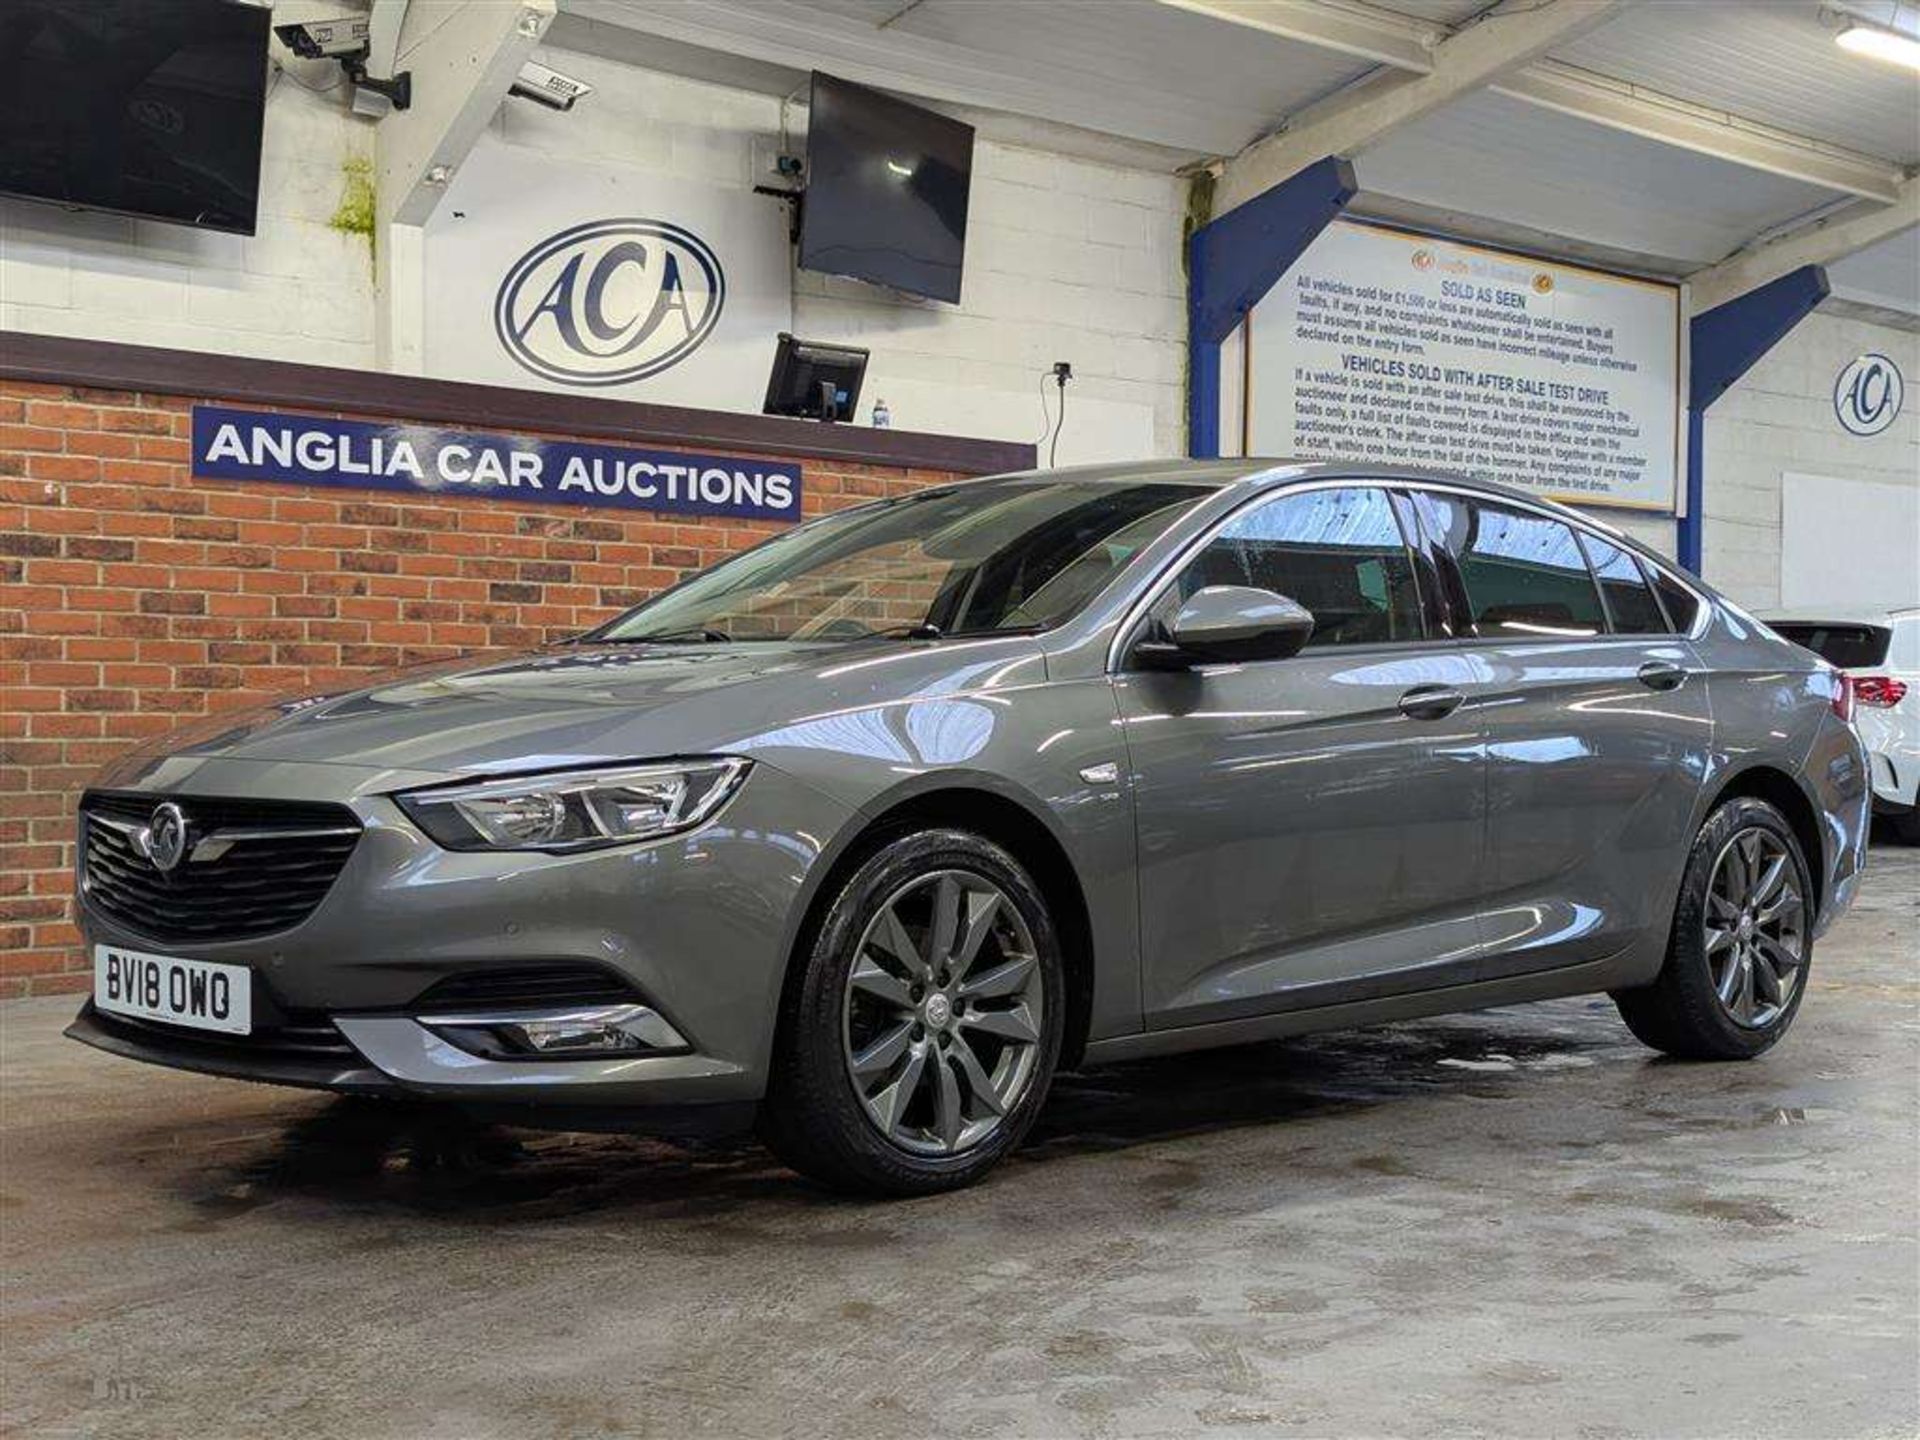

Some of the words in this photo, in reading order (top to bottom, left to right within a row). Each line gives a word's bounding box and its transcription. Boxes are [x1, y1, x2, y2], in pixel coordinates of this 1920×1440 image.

[516, 240, 696, 358] ACA
[1312, 277, 1352, 295] vehicles
[1441, 279, 1473, 300] SOLD
[1476, 285, 1491, 303] AS
[1495, 289, 1526, 309] SEEN
[1296, 325, 1338, 342] declared
[1357, 334, 1371, 347] the
[1378, 321, 1416, 338] vehicles
[1313, 370, 1347, 386] vehicle
[1362, 376, 1382, 390] sold
[1341, 354, 1404, 377] VEHICLES
[1409, 363, 1440, 382] SOLD
[1444, 368, 1473, 387] WITH
[1477, 373, 1513, 392] AFTER
[1516, 378, 1545, 396] SALE
[1548, 383, 1574, 400] TEST
[1578, 387, 1608, 405] DRIVE
[1295, 385, 1346, 402] auctioneer
[1350, 392, 1366, 404] and
[1370, 395, 1410, 409] declared
[1840, 363, 1895, 424] ACA
[1295, 401, 1321, 415] faults
[206, 423, 424, 480] ANGLIA
[437, 444, 543, 488] CAR
[558, 457, 794, 510] AUCTIONS
[107, 953, 160, 1009] BV18
